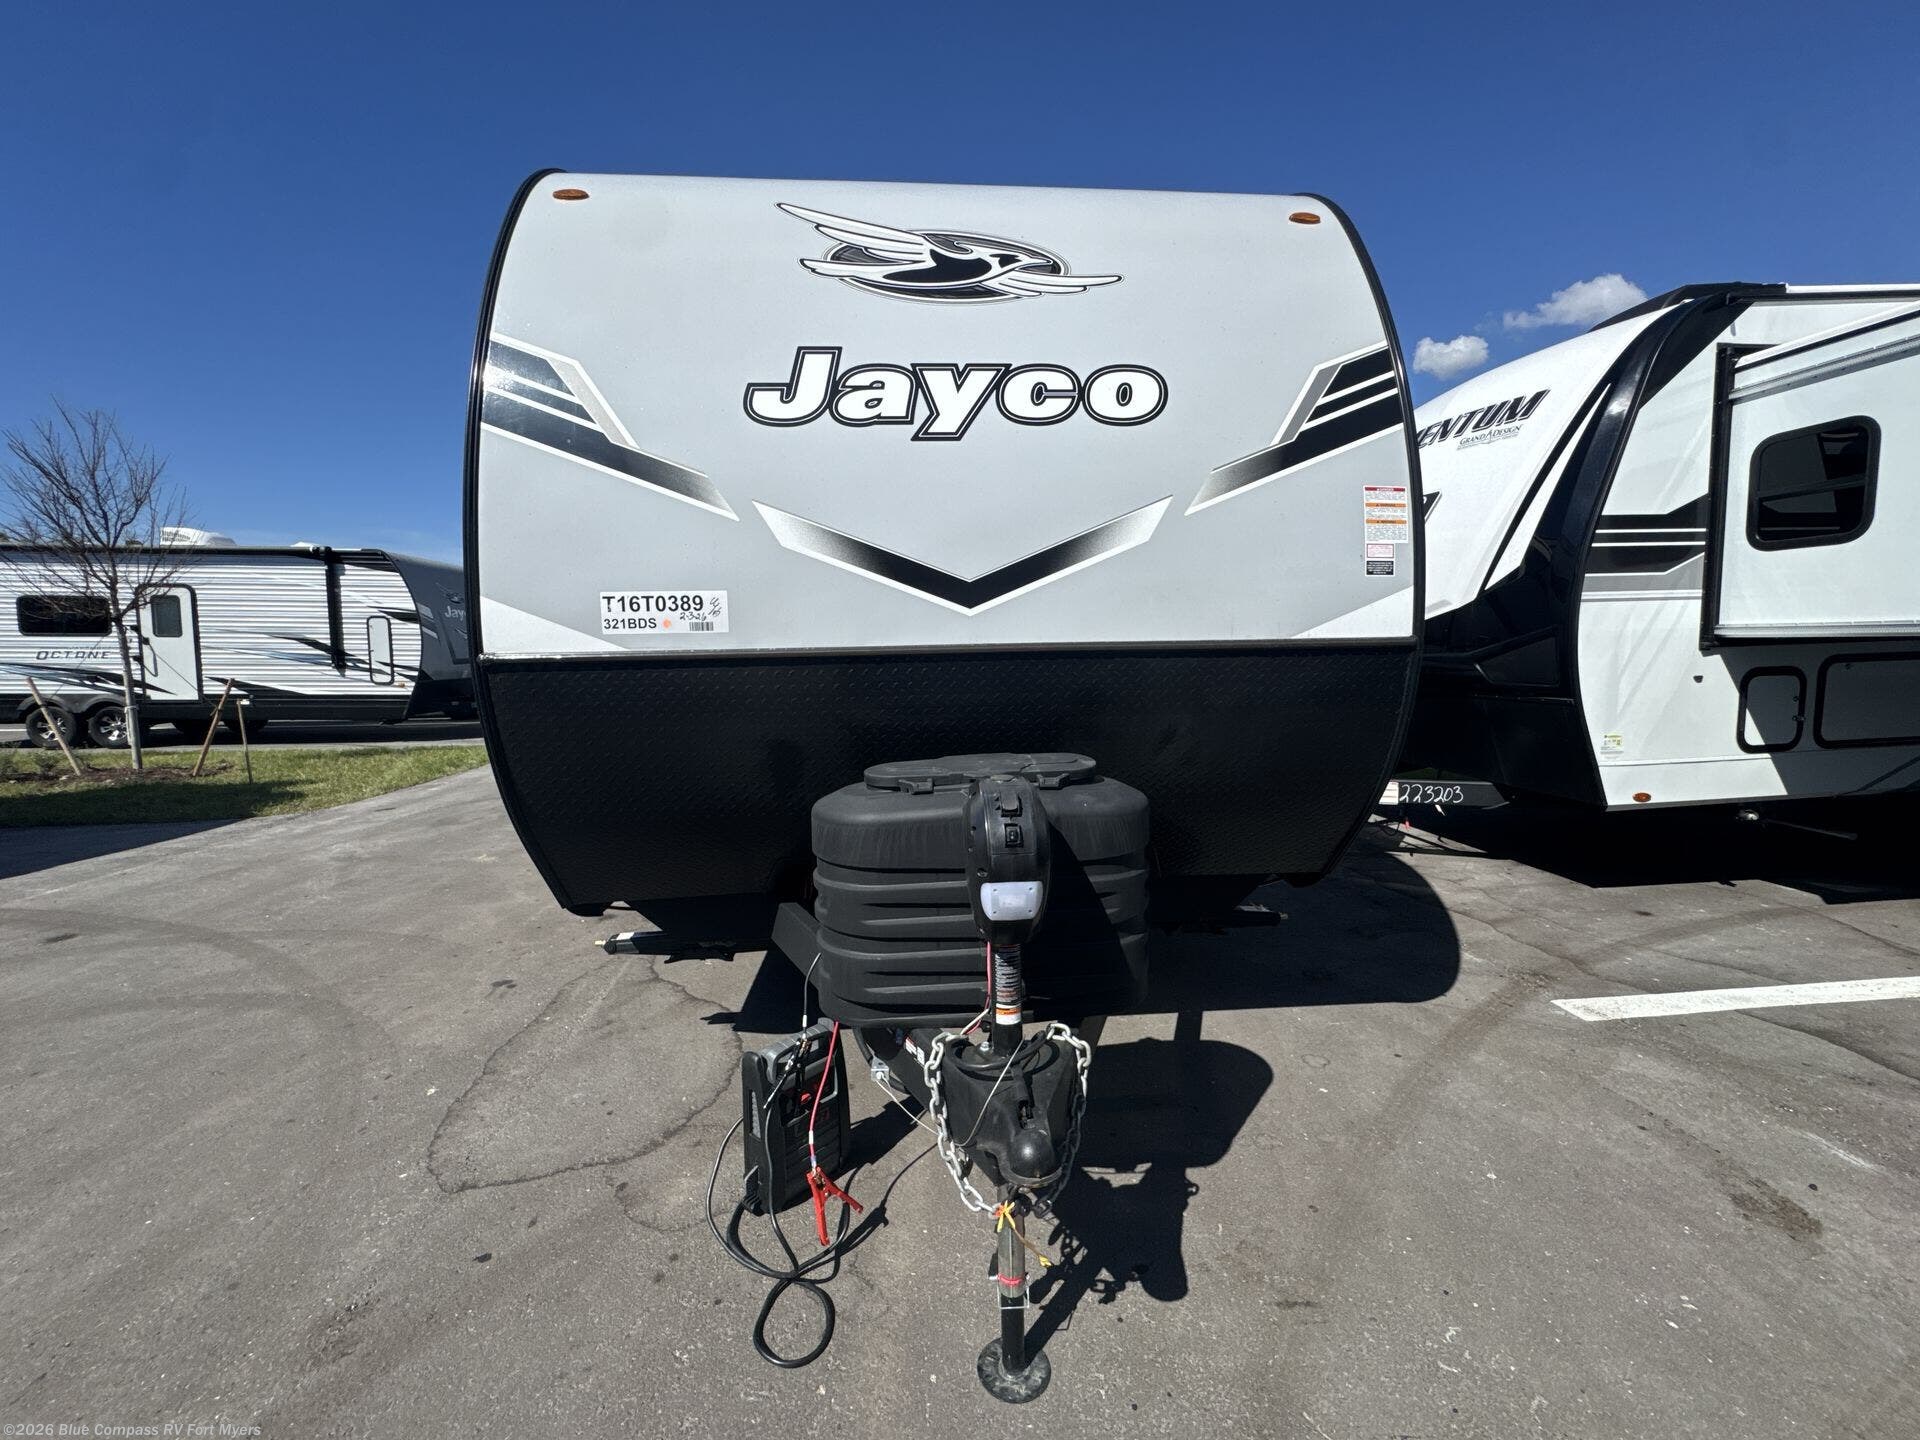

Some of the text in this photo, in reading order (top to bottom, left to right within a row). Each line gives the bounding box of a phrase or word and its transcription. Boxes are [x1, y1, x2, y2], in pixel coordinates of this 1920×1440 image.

[743, 346, 1169, 441] Jayco
[1416, 388, 1551, 449] ENTUM
[602, 594, 704, 613] T16T0389
[603, 617, 657, 630] 321BDS
[35, 650, 112, 661] OCTANE
[1399, 783, 1464, 804] 223203
